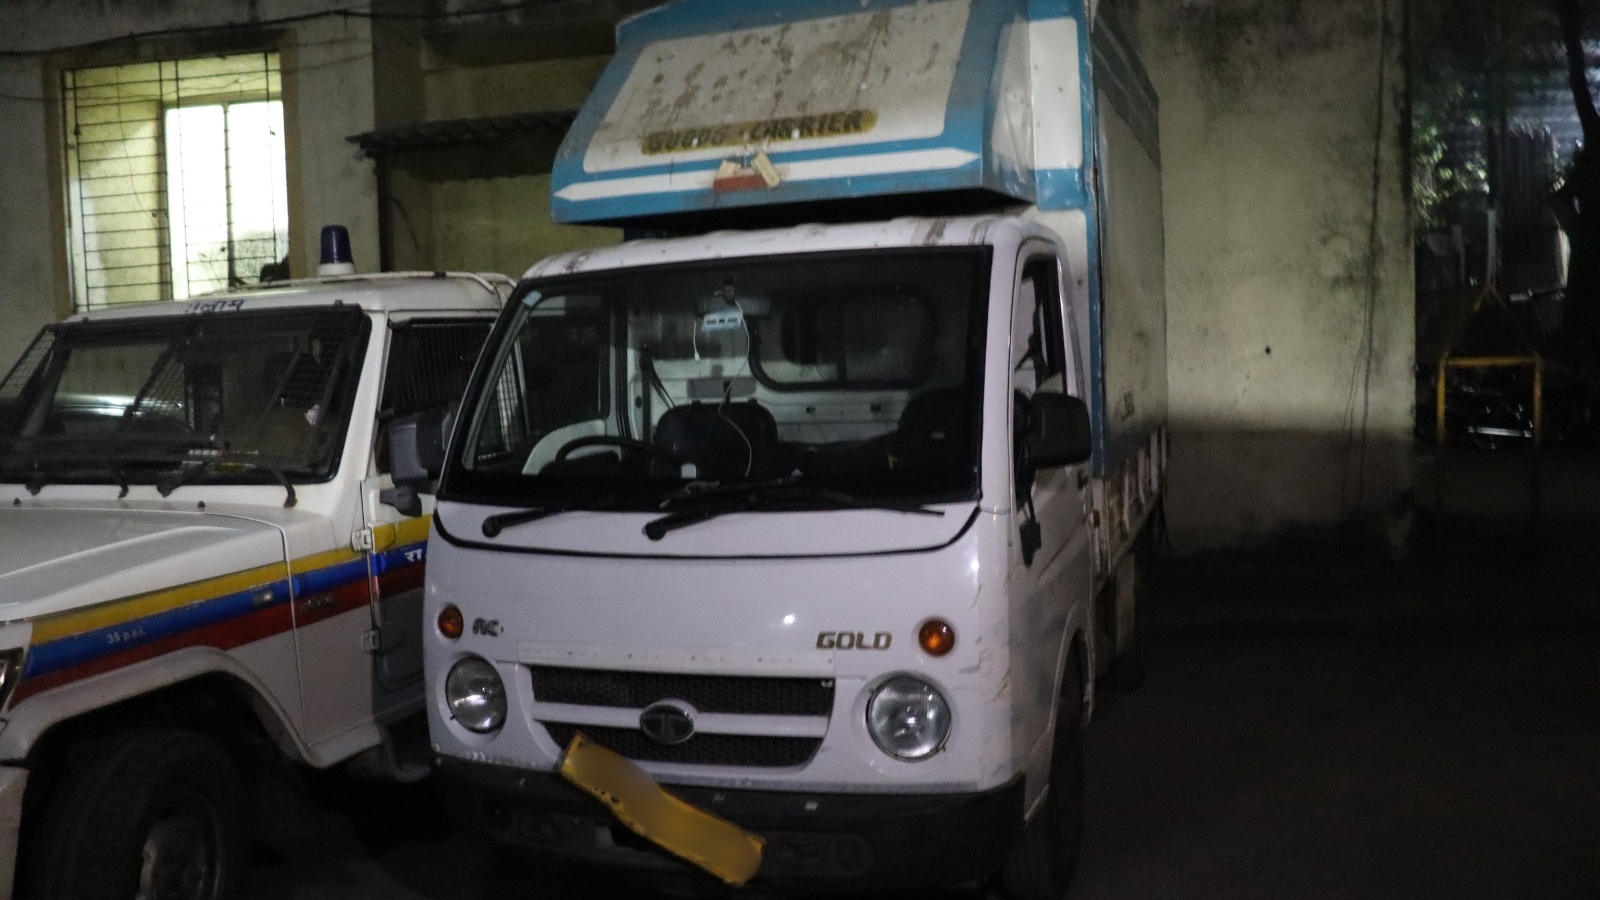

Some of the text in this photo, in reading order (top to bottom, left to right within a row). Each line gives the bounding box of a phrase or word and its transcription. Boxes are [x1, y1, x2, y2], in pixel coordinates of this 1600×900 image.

[748, 110, 864, 141] CARRIER
[107, 631, 120, 645] 35
[816, 631, 893, 650] GOLD
